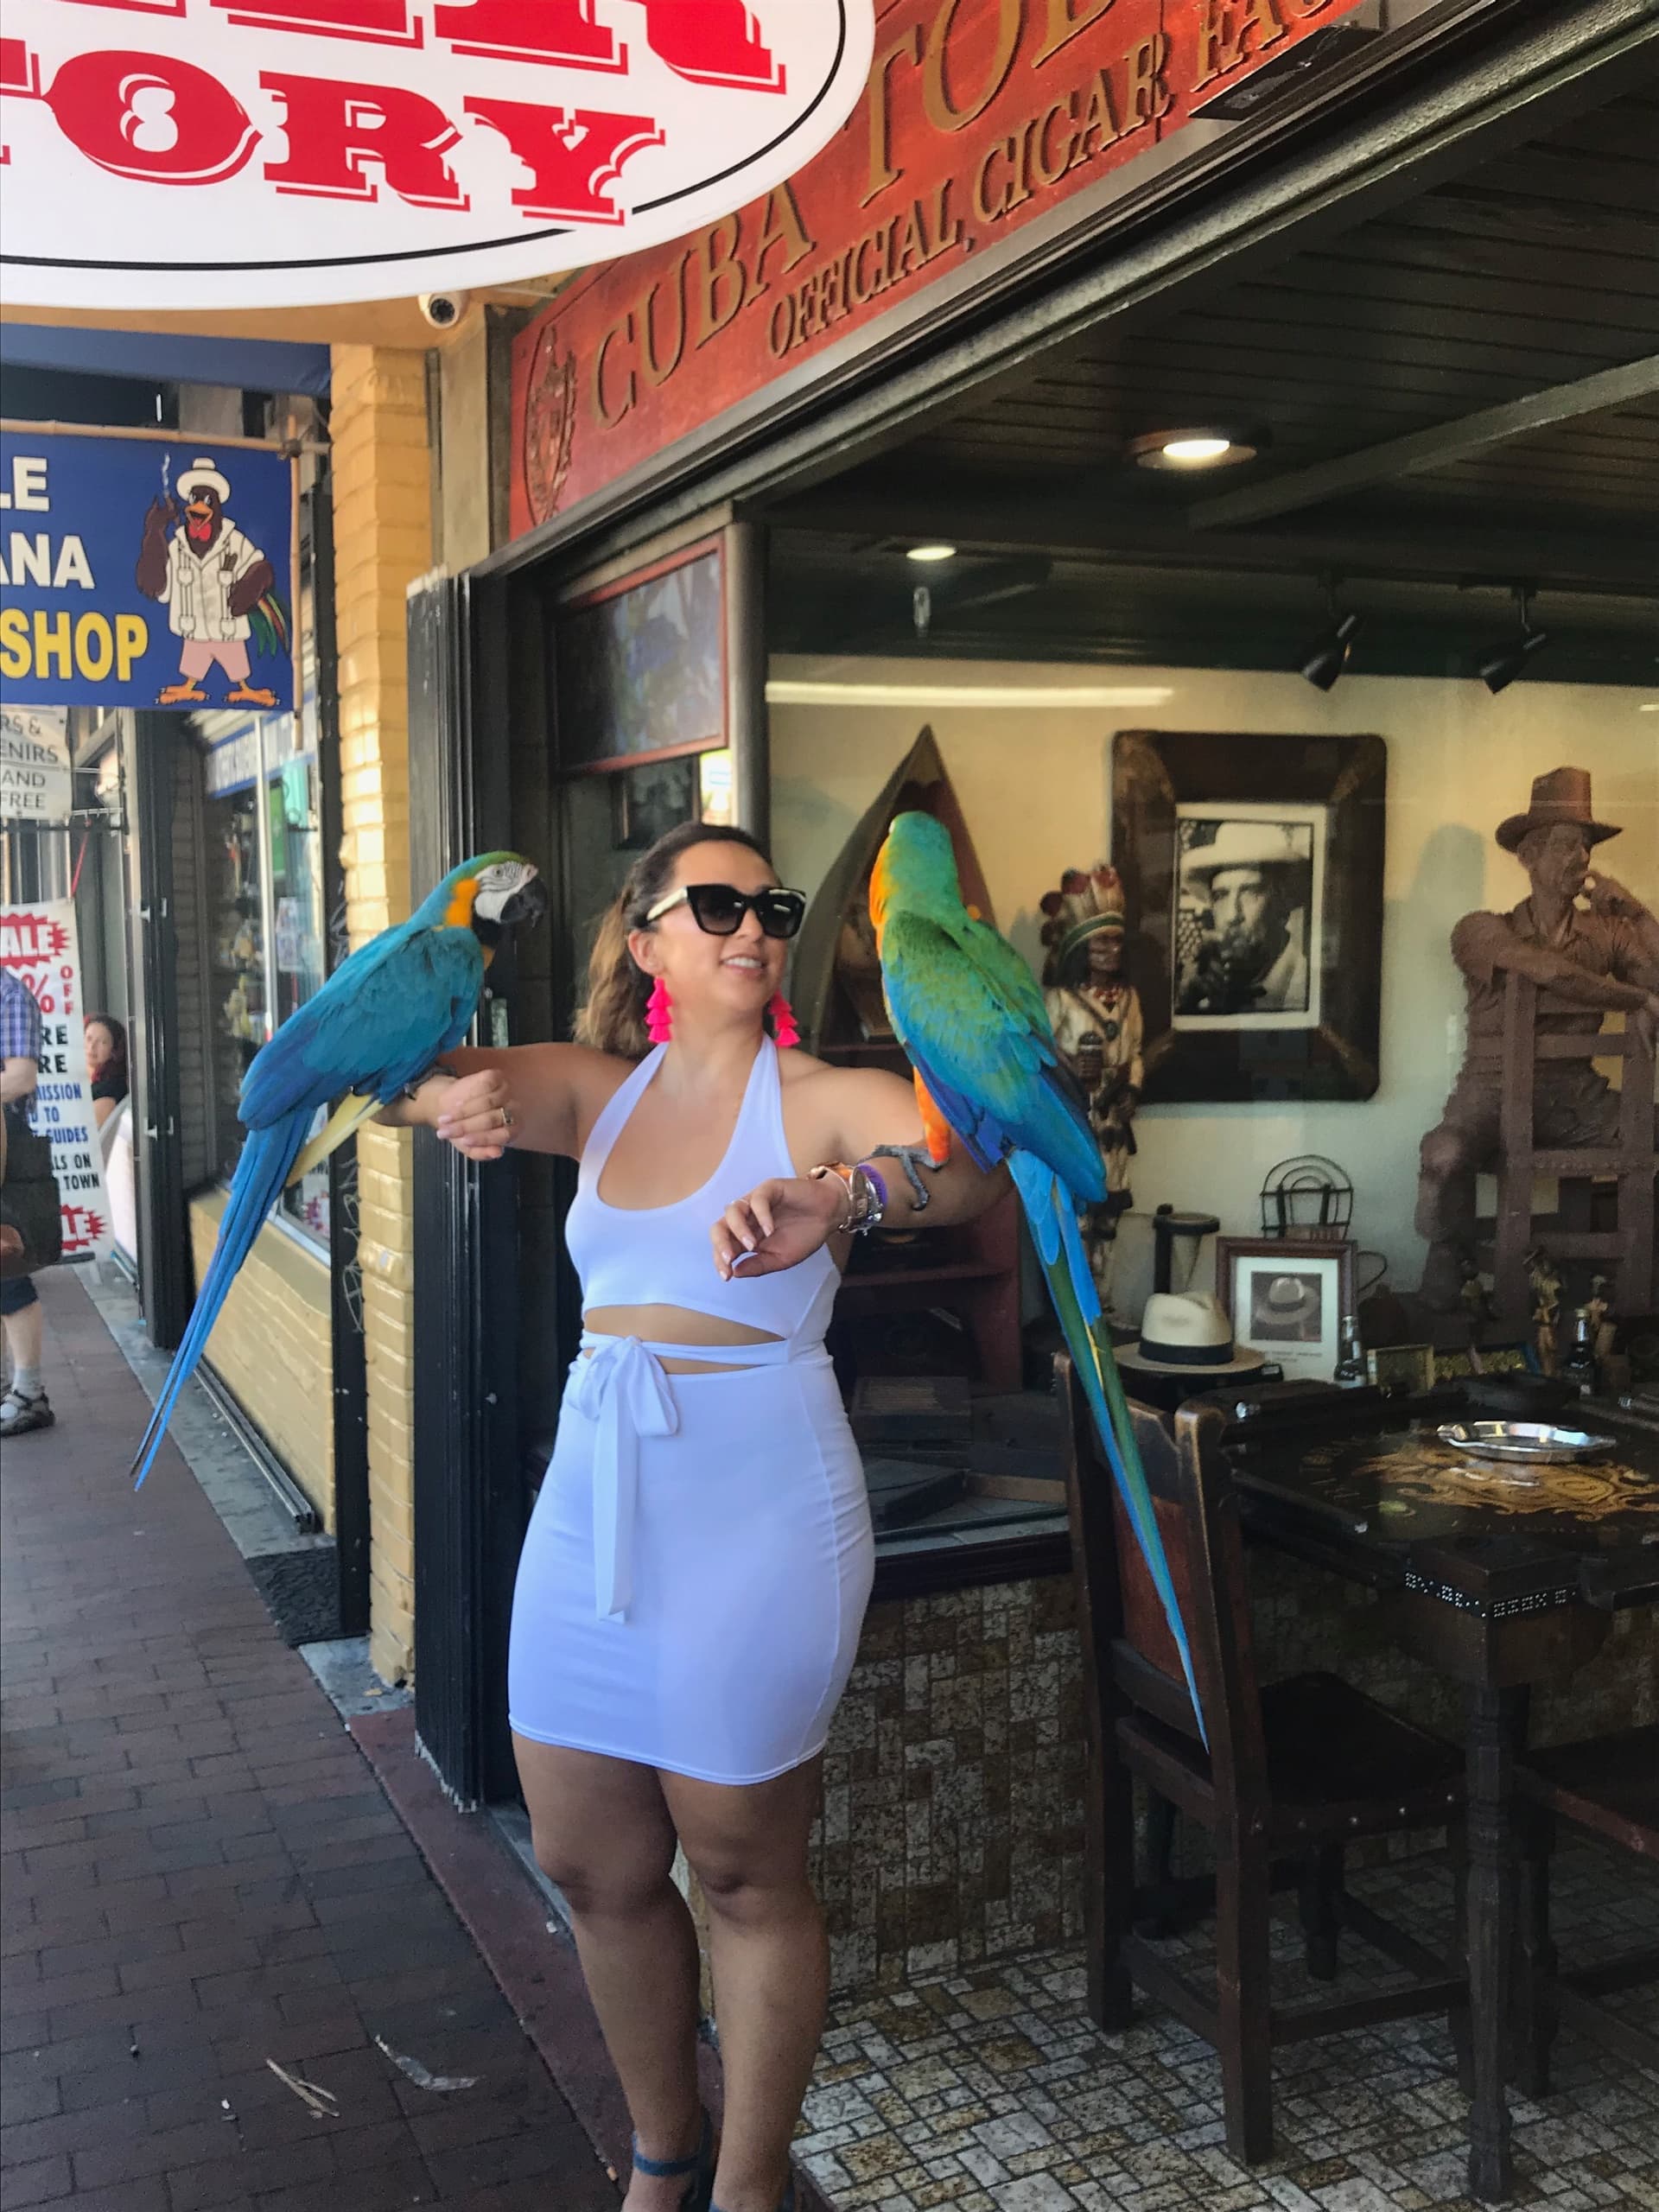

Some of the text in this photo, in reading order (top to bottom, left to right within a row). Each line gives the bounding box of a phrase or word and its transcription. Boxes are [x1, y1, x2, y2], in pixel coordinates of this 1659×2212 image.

[0, 40, 666, 226] ORY
[973, 31, 1175, 223] CIGAR
[1189, 0, 1329, 93] FA
[590, 178, 817, 431] CUBA
[0, 607, 149, 682] SHOP
[44, 1107, 60, 1123] TO
[64, 1173, 100, 1191] TOWN
[74, 1154, 92, 1169] ON
